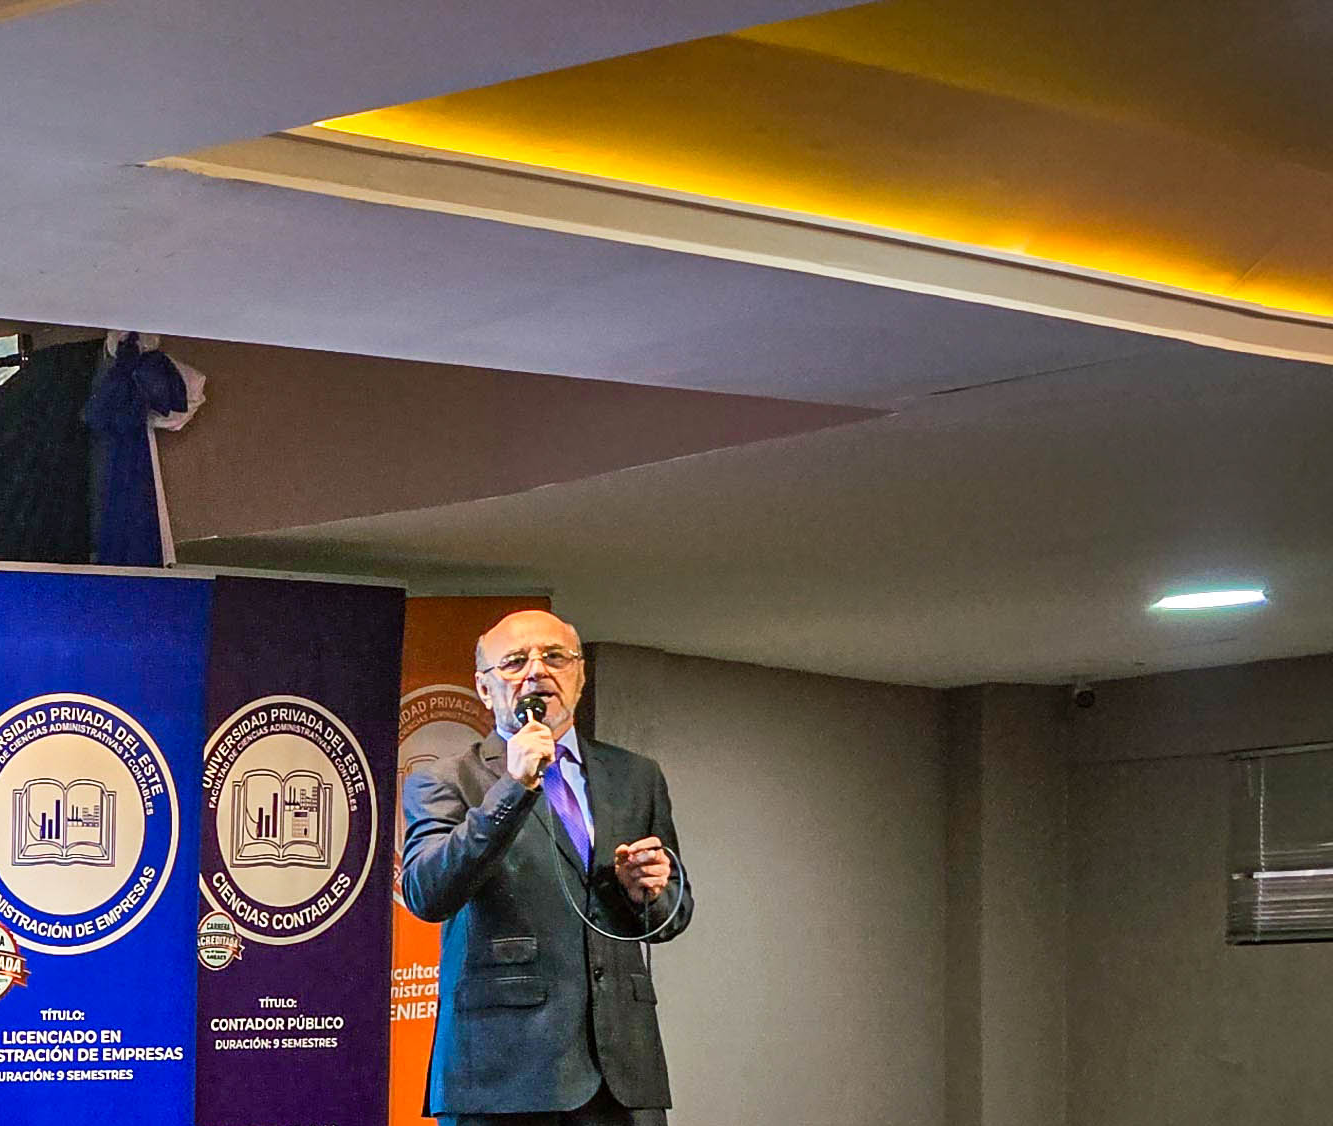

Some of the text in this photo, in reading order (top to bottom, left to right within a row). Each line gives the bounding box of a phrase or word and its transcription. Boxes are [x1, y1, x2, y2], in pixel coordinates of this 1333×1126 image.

[50, 707, 113, 733] PRIVADA
[115, 727, 139, 756] DEL
[138, 754, 164, 796] ESTE
[202, 708, 365, 794] UNIVERSIDAD PRIVADA DEL ESTE
[10, 726, 47, 752] CIENCIAS
[50, 723, 124, 753] ADMINISTRATIVAS
[127, 758, 153, 815] CONTABLES
[75, 921, 95, 937] DE
[96, 866, 155, 930] EMPRESAS
[213, 872, 351, 930] CIENCIAS CONTABLES
[259, 996, 297, 1008] TÍTULO:
[41, 1008, 85, 1020] TÍTULO:
[210, 1014, 344, 1031] CONTADOR PÚBLICO
[3, 1030, 121, 1044] LICENCIADO EN
[215, 1037, 337, 1050] DURACIÓN: 9 SEMESTRES
[77, 1048, 99, 1061] DE
[103, 1047, 183, 1061] EMPRESAS
[57, 1071, 64, 1081] 9
[67, 1070, 133, 1081] SEMESTRES
